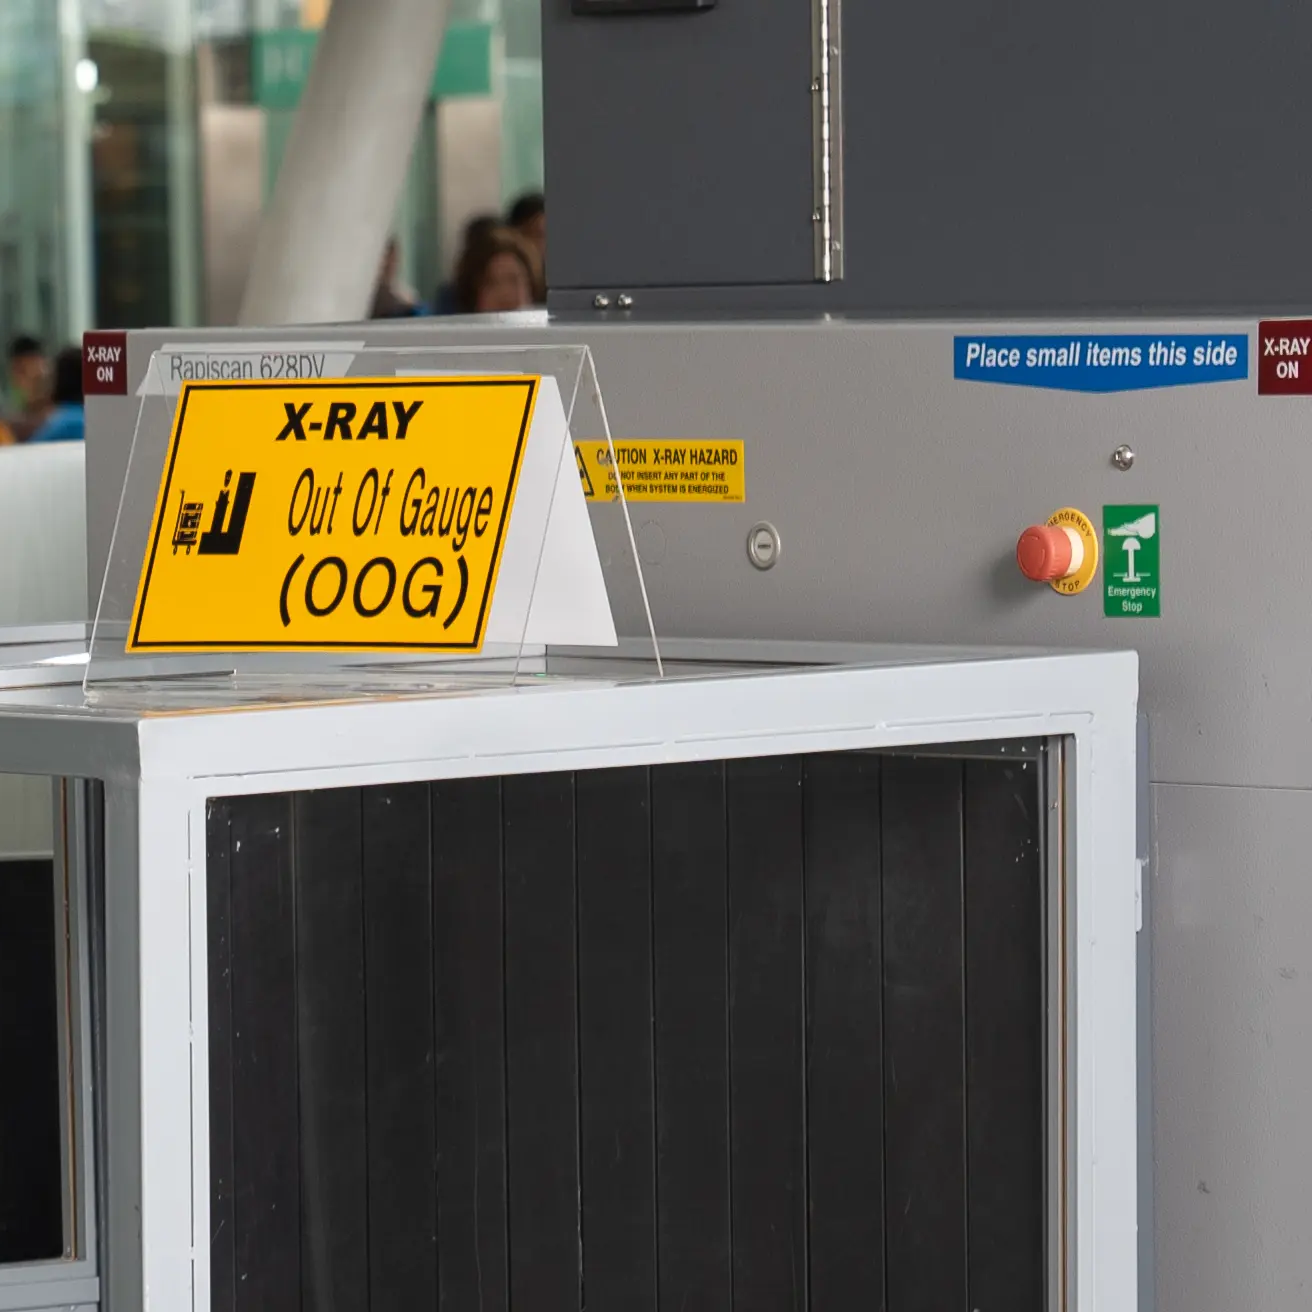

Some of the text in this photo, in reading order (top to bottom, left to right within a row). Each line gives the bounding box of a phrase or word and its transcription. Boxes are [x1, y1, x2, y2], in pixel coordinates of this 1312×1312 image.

[87, 347, 121, 362] X-RAY
[966, 340, 1238, 367] Place small items this side
[1263, 337, 1311, 356] X-RAY
[96, 367, 114, 382] ON
[170, 354, 326, 381] Rapiscan 628DV
[1276, 360, 1299, 379] ON
[275, 401, 424, 441] X-RAY
[597, 447, 738, 465] CAUTION X-RAY HAZARD
[620, 471, 635, 480] NOT
[637, 471, 662, 480] INSERT
[664, 471, 678, 480] ANY
[680, 471, 699, 481] PART
[700, 472, 711, 481] OF
[712, 472, 725, 481] THE
[627, 484, 648, 493] WHEN
[649, 484, 678, 493] SYSTEM
[679, 484, 686, 493] IS
[688, 485, 729, 494] ENERGIZED
[288, 467, 493, 552] Out Of Gauge
[1046, 510, 1092, 537] MERGENCY
[279, 553, 469, 630] (OOG)
[1108, 586, 1157, 599] Emergency
[1122, 601, 1143, 613] Stop
